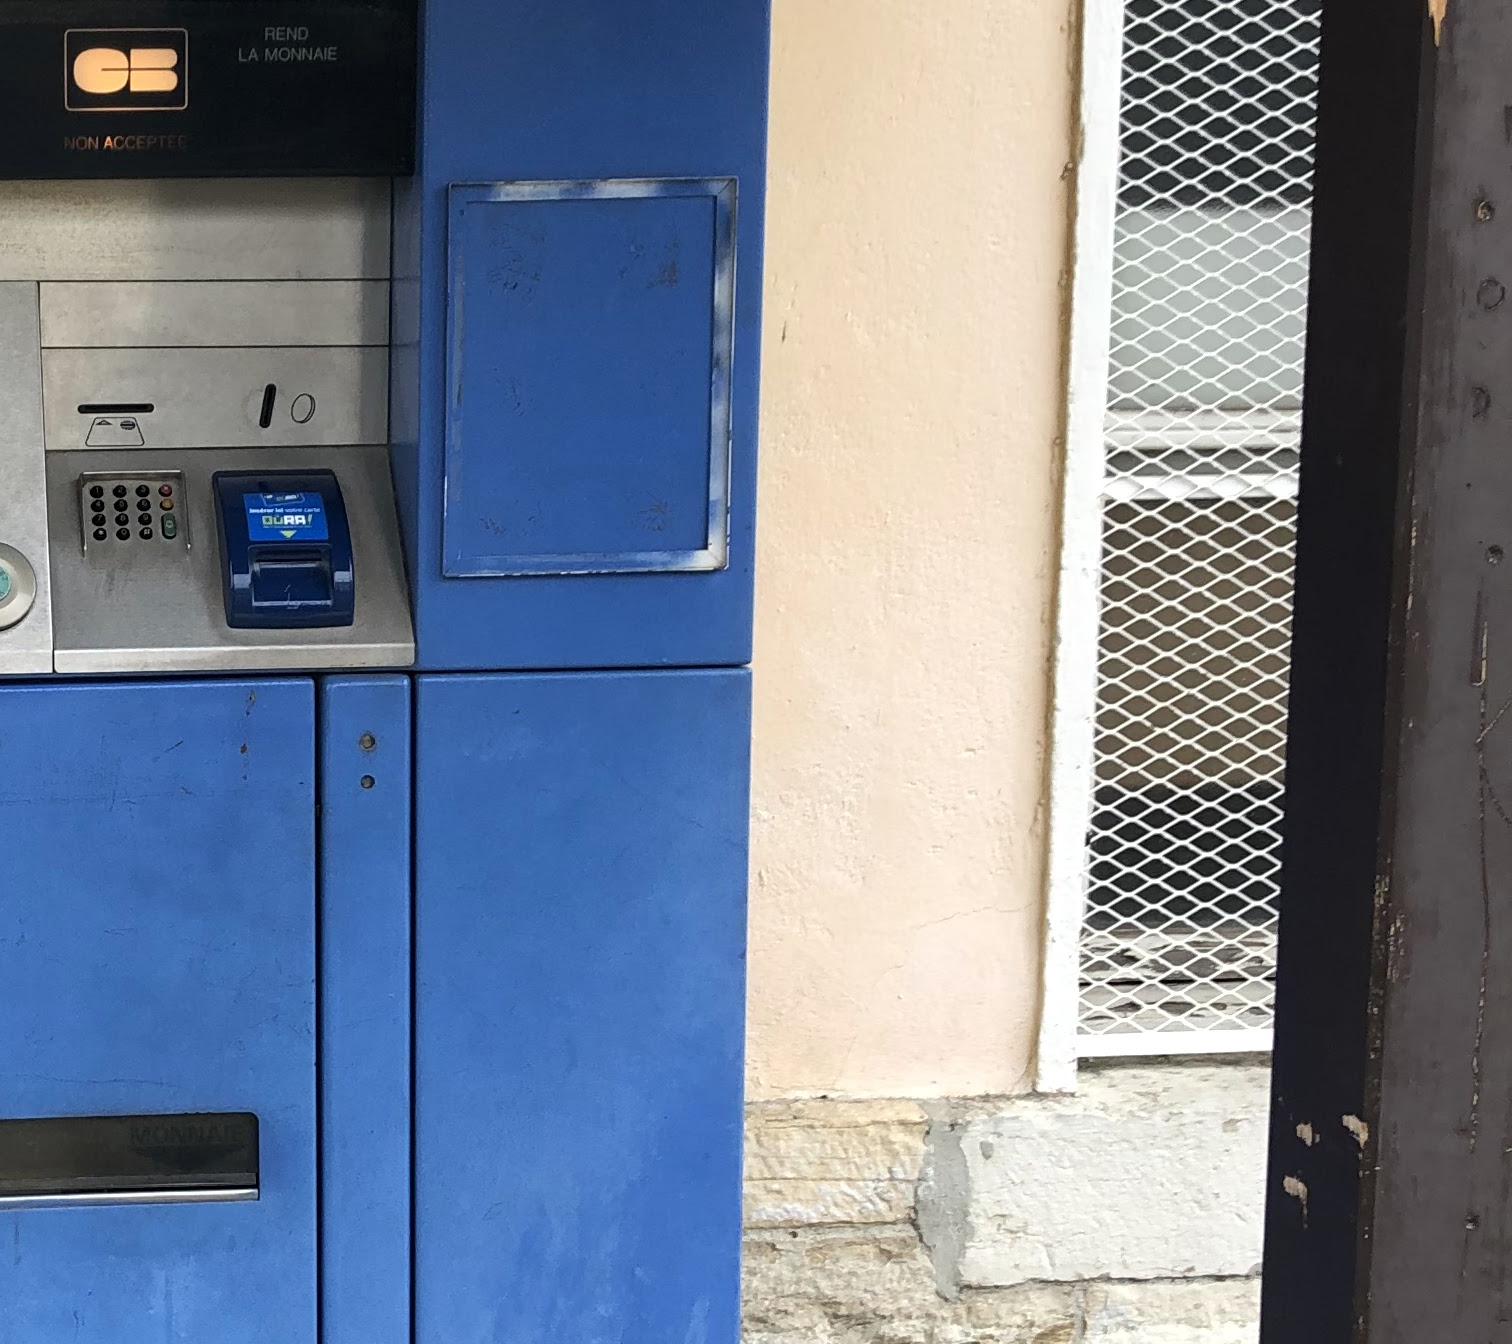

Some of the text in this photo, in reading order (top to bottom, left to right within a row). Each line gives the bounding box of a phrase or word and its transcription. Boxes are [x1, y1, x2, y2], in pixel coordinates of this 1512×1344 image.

[264, 26, 309, 41] REND
[238, 46, 338, 62] LA MONNAIE
[63, 135, 99, 151] NON
